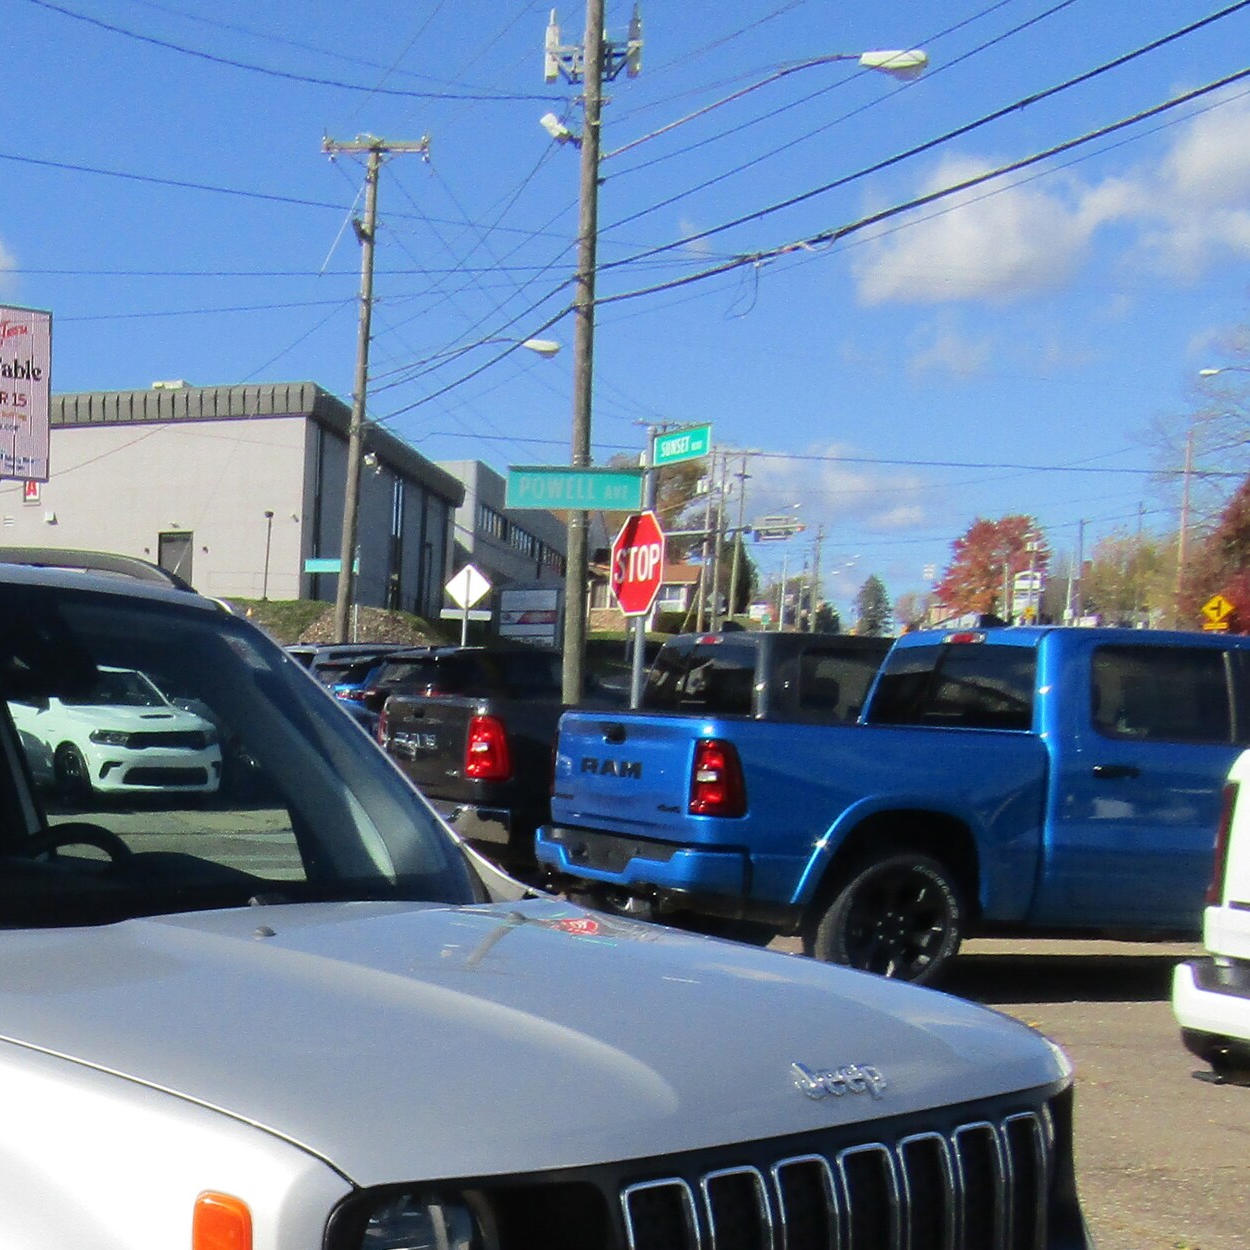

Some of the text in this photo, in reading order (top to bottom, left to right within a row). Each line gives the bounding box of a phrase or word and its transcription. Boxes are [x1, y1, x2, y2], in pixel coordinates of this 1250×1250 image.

[12, 392, 27, 408] 15
[661, 435, 690, 457] SUNSET
[518, 476, 595, 500] POWELL
[614, 543, 660, 584] STOP
[580, 757, 642, 780] RAM
[791, 1062, 887, 1101] Jeep
